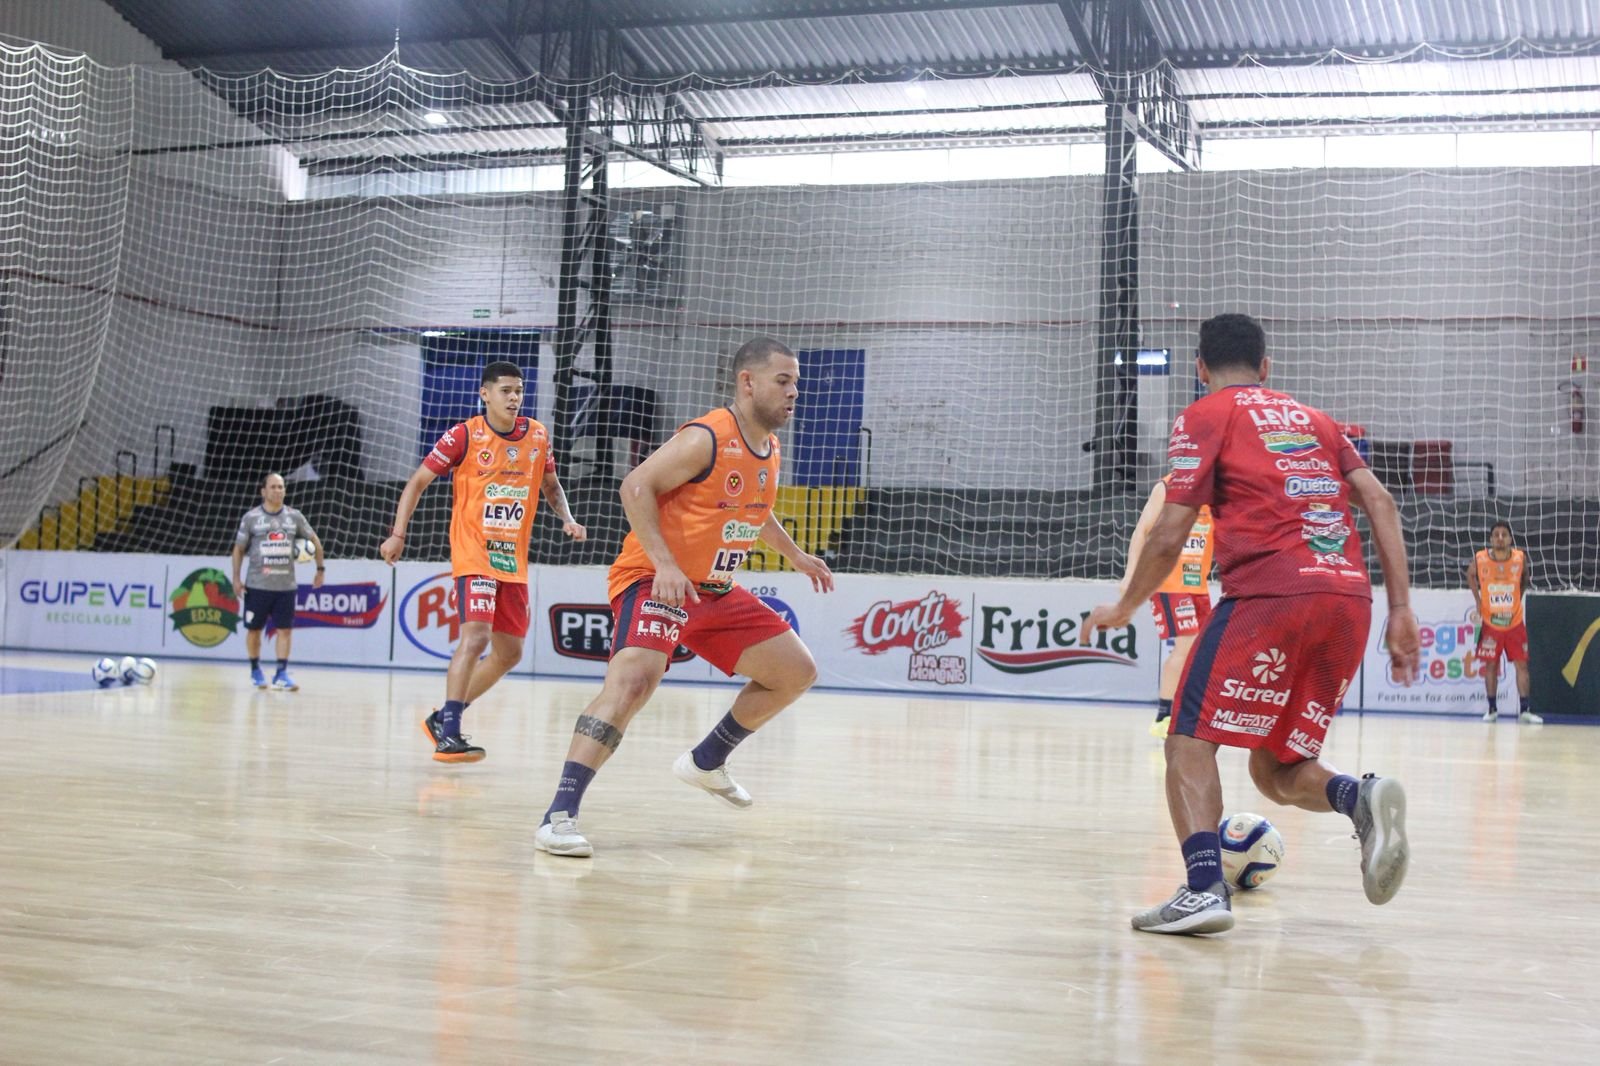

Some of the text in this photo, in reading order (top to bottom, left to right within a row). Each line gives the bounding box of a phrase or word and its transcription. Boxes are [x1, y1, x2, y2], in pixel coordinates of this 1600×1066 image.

[1248, 406, 1311, 426] LEVO
[1287, 477, 1339, 496] Duetto
[485, 502, 524, 520] LEVO
[20, 581, 162, 608] GUIPEVEL
[47, 612, 132, 626] RECICLAGEM
[561, 611, 615, 639] PR
[862, 591, 945, 645] Conti
[637, 620, 680, 642] LEVO
[912, 628, 949, 653] Cola
